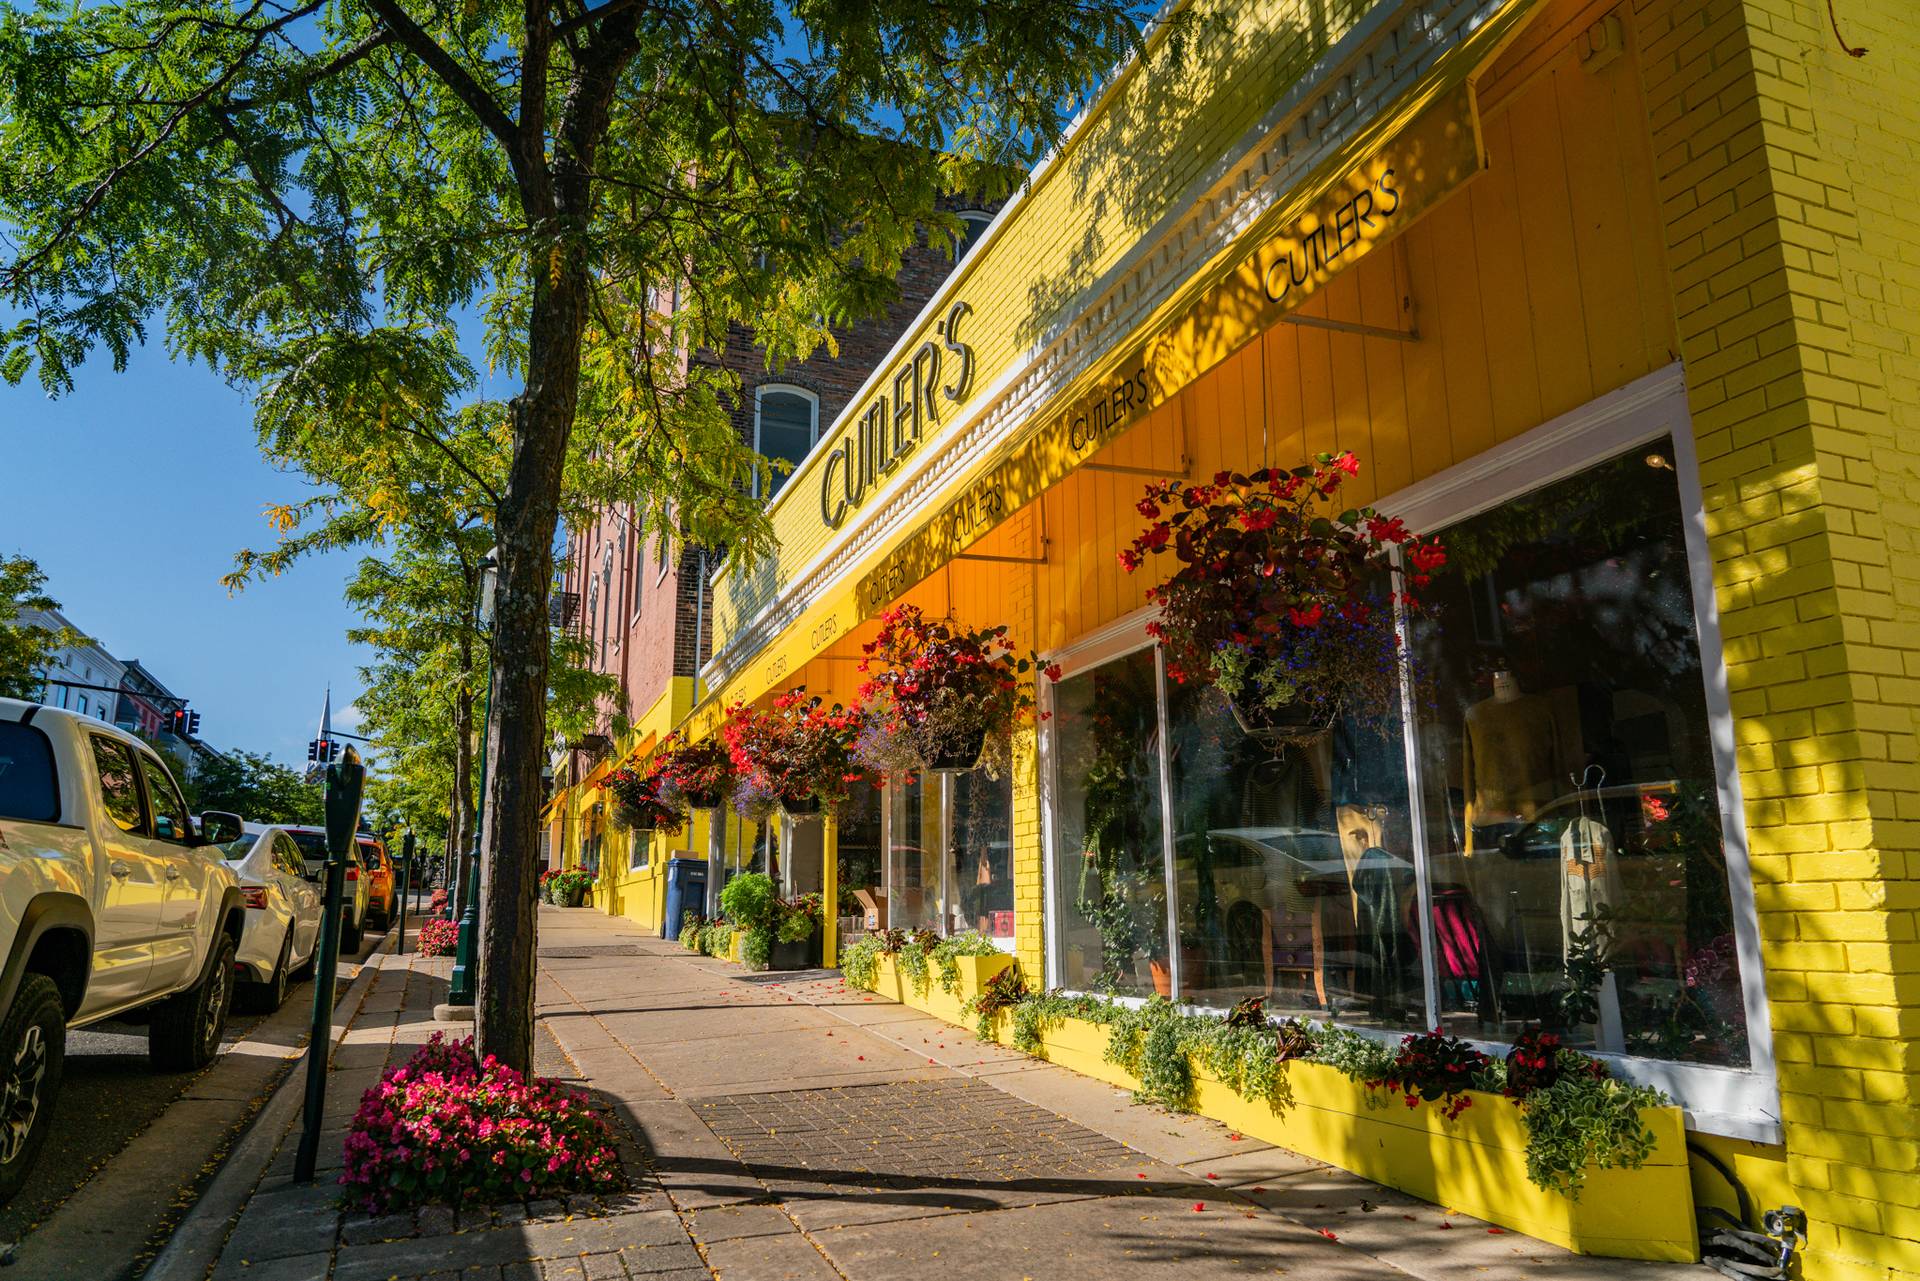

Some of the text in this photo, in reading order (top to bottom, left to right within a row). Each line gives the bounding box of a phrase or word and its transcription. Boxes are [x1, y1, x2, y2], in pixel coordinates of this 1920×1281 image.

[1264, 168, 1399, 303] CUTLER'S
[821, 301, 974, 528] CUTLER'S
[1071, 368, 1148, 451] CUTLER'S
